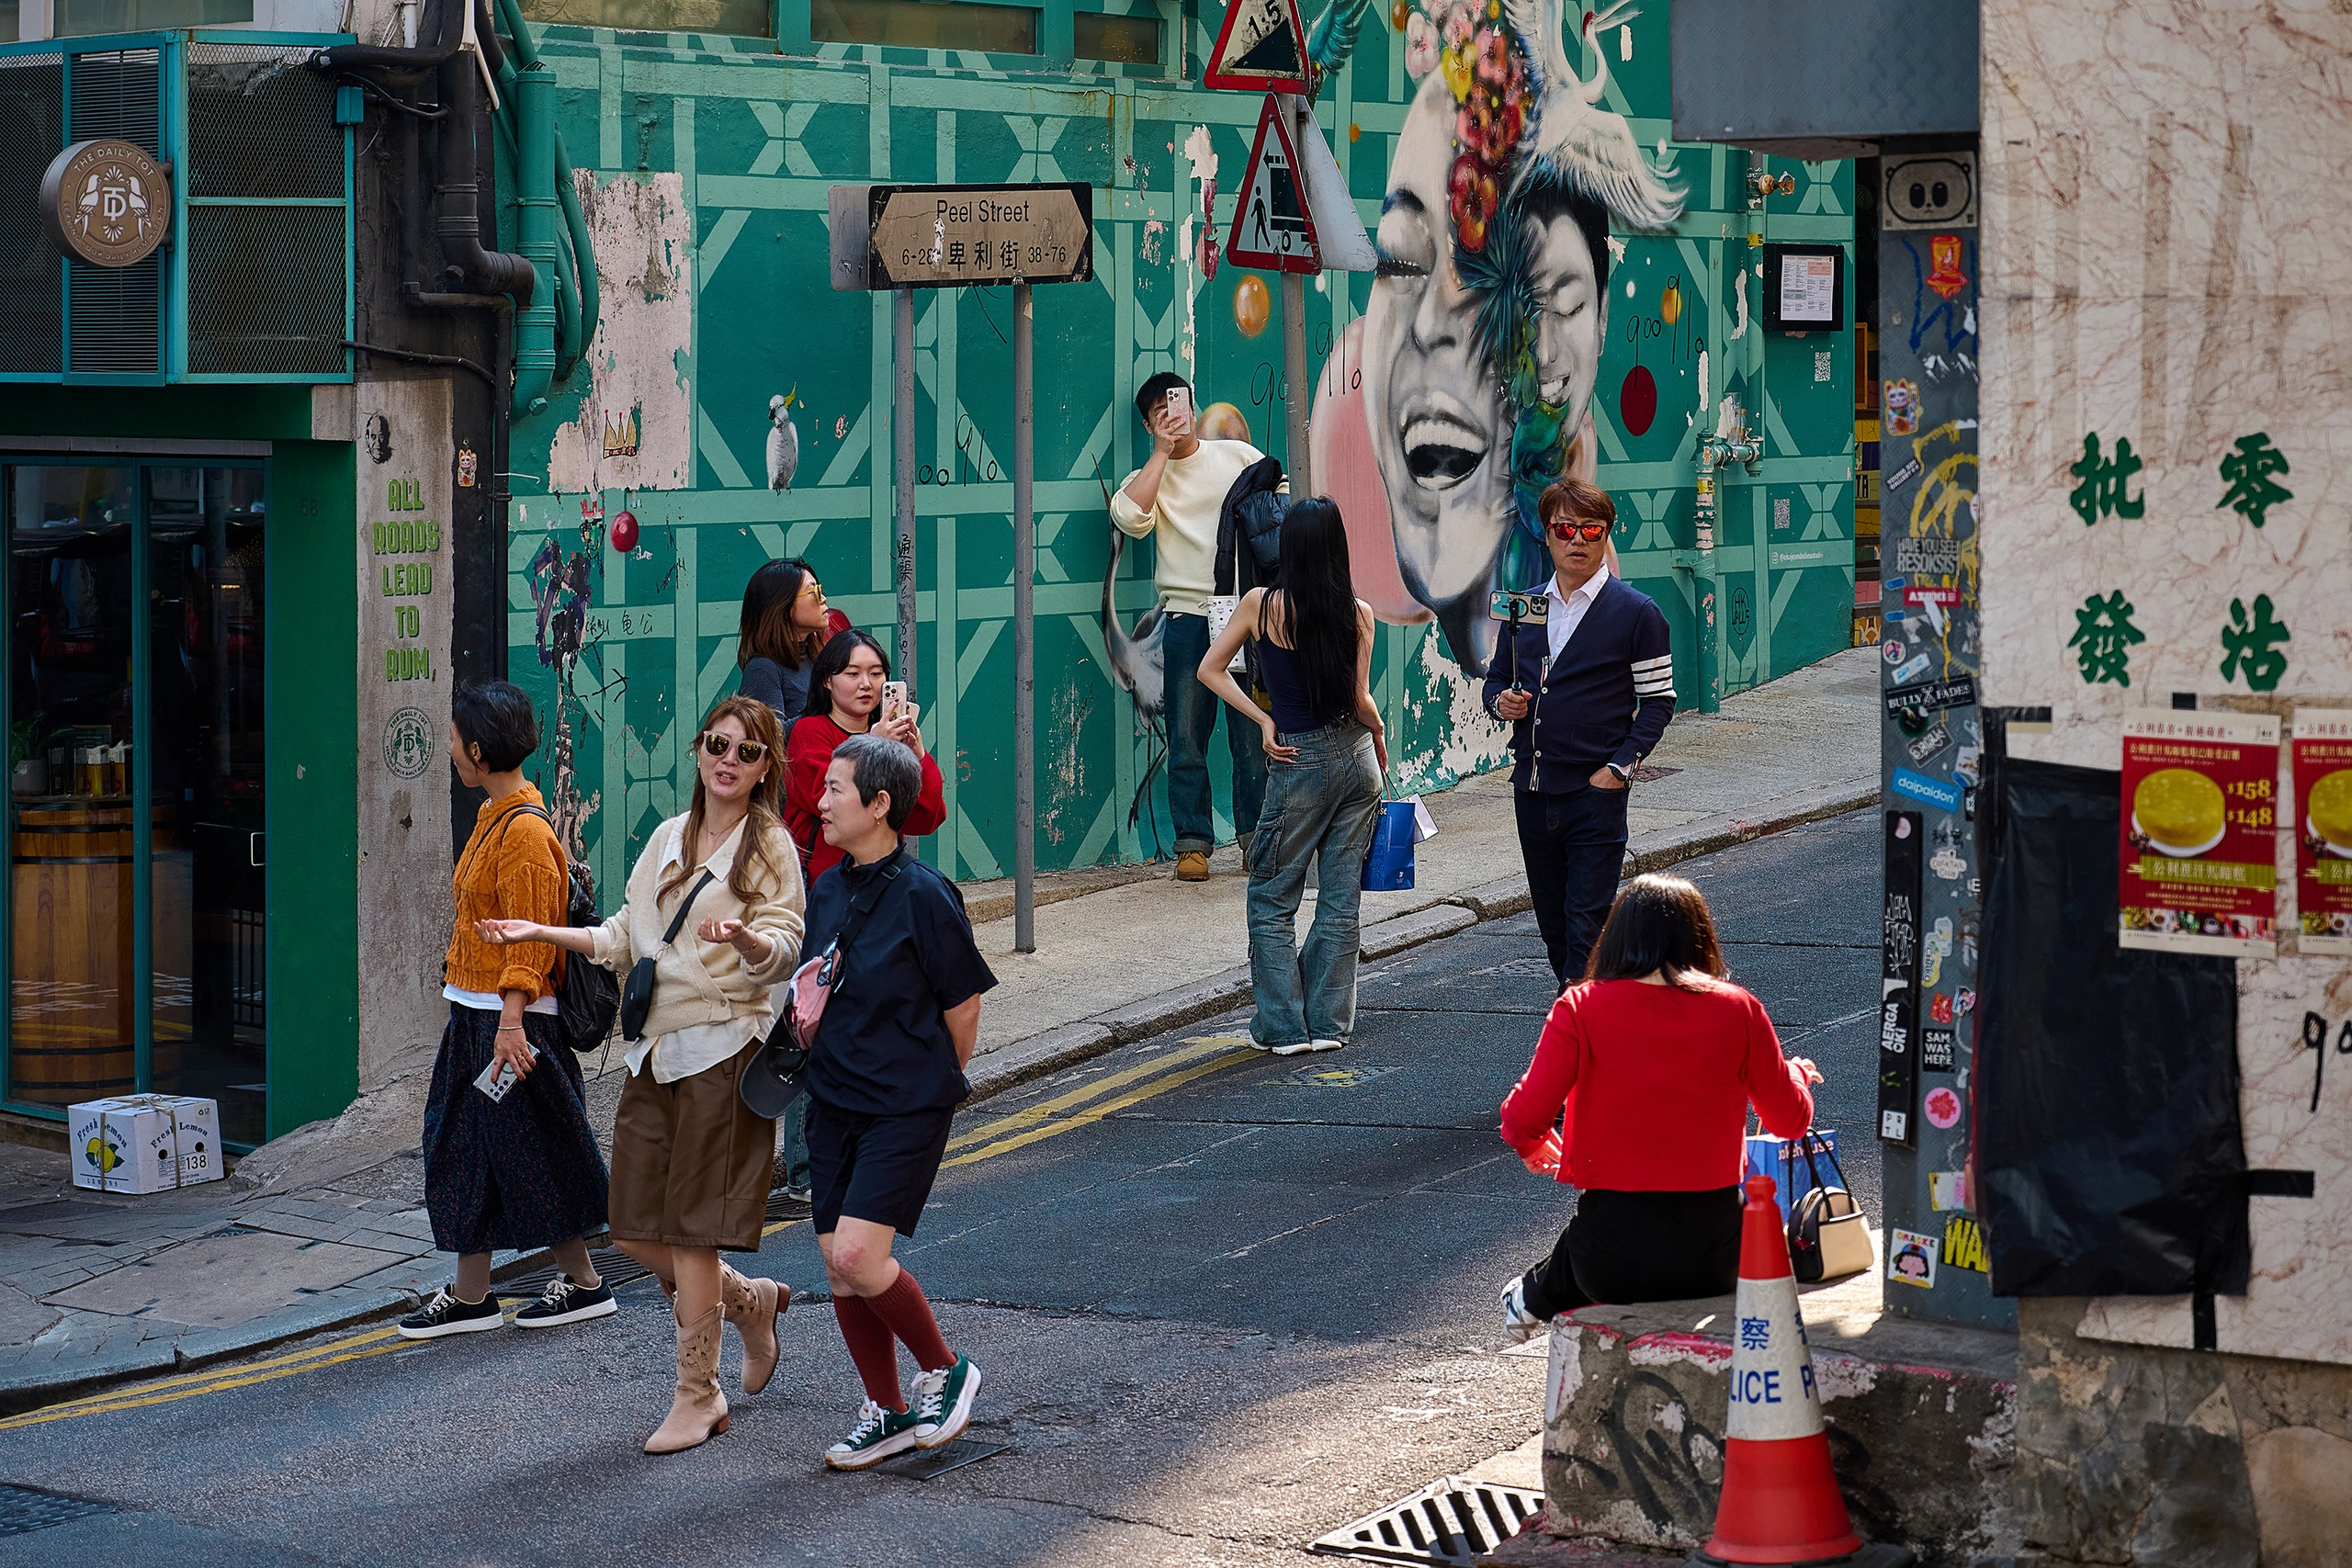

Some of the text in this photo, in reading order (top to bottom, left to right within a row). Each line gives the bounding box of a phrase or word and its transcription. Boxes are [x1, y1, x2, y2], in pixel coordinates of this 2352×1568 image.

[1248, 0, 1282, 39] 1:5
[74, 147, 154, 176] THE DAILY TOT
[936, 199, 1030, 223] Peel Street
[947, 240, 1019, 271] 卑利街
[300, 498, 319, 516] 58
[387, 479, 425, 511] ALL
[372, 520, 440, 555] ROADS
[1897, 537, 1920, 552] HAVE
[1921, 538, 1939, 553] YOU
[381, 562, 432, 596] LEAD
[394, 605, 420, 637] TO
[386, 647, 430, 682] RUM
[1888, 684, 1971, 709] BULLY FADES
[390, 716, 401, 728] THE
[2226, 778, 2271, 800] $158
[2226, 807, 2272, 829] $148
[1881, 1003, 1899, 1051] AERGA
[1926, 1032, 1951, 1043] SAM
[1925, 1043, 1951, 1055] WAS
[77, 1118, 98, 1143] Fresh
[178, 1122, 209, 1137] Lemon
[186, 1155, 207, 1170] 138
[1944, 1218, 1987, 1273] WA
